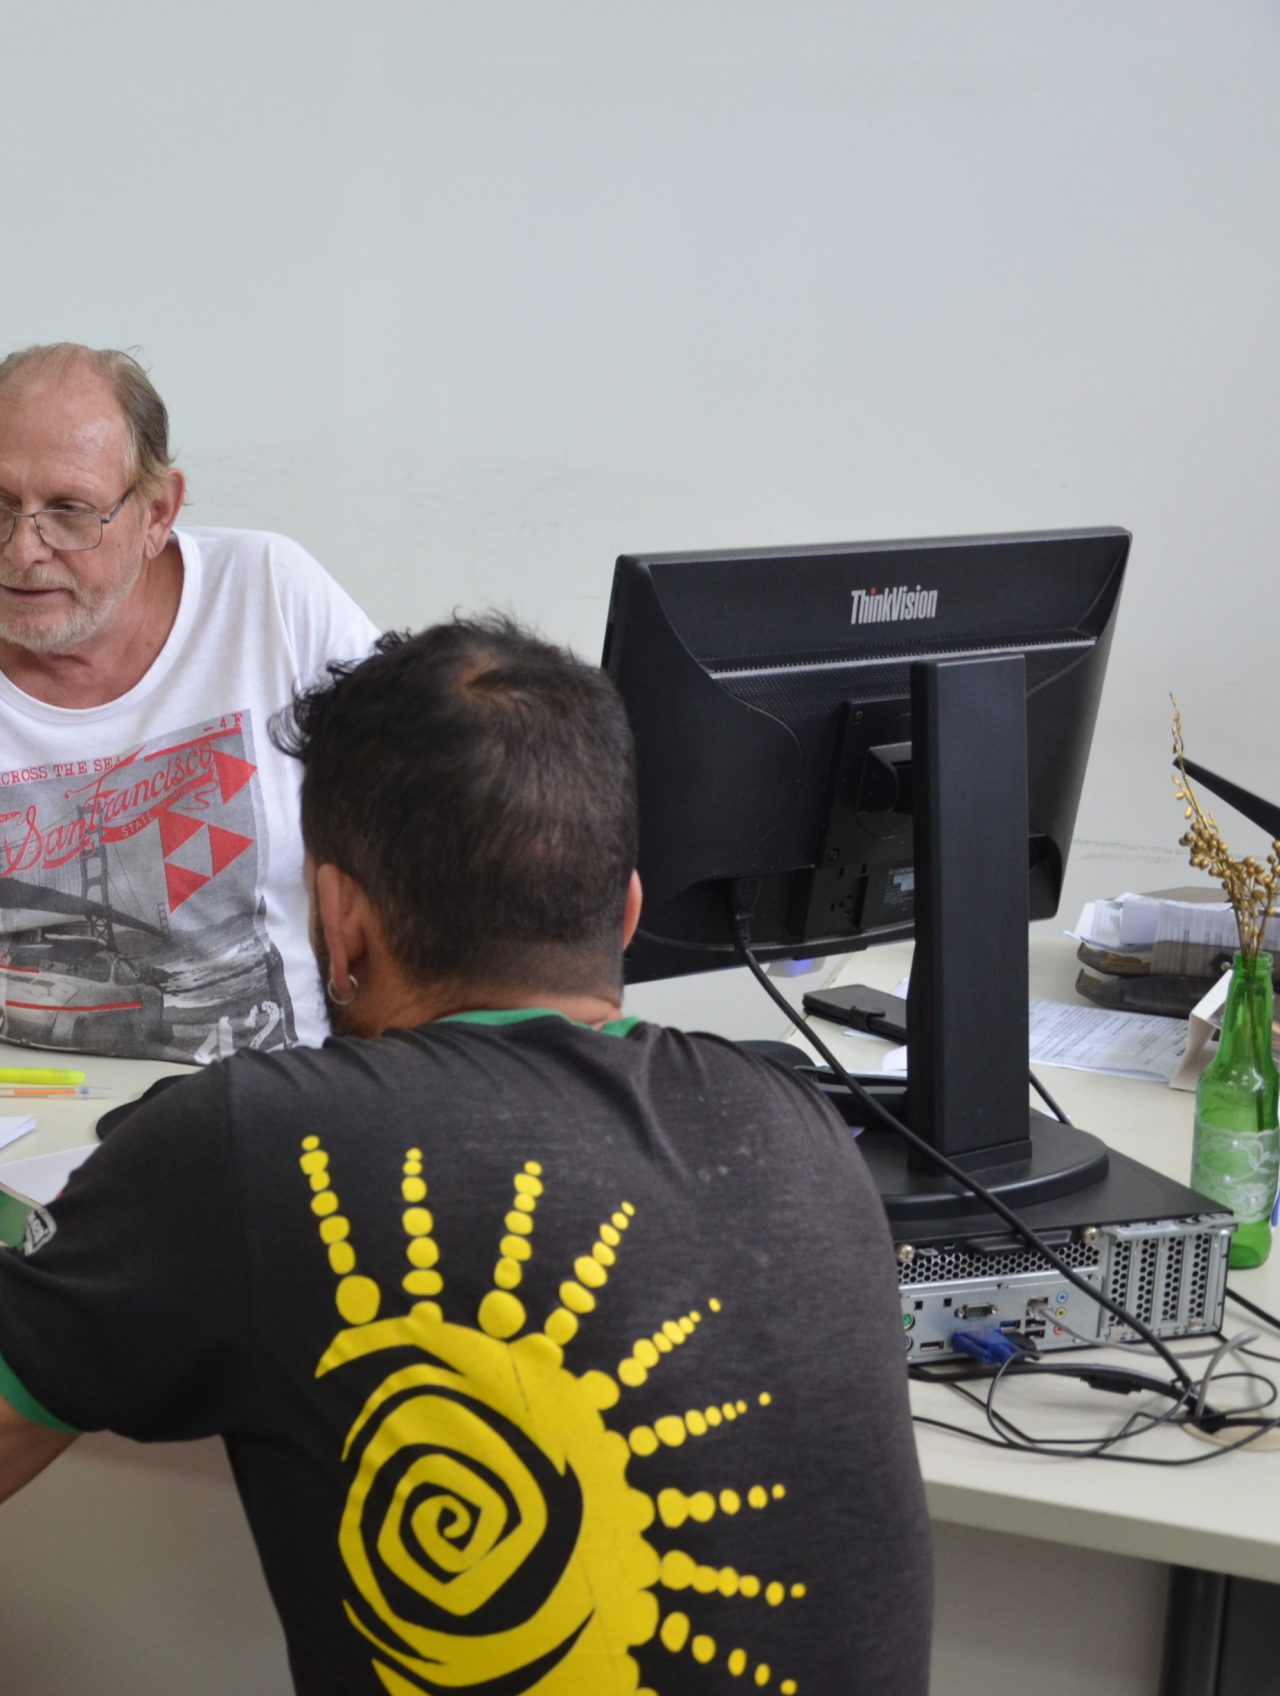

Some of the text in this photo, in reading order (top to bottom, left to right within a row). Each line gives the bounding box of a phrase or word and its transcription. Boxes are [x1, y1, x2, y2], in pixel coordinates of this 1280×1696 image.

[851, 585, 938, 624] ThinkVision
[52, 762, 87, 779] THE
[65, 740, 214, 829] Francisco
[122, 811, 153, 837] STATE
